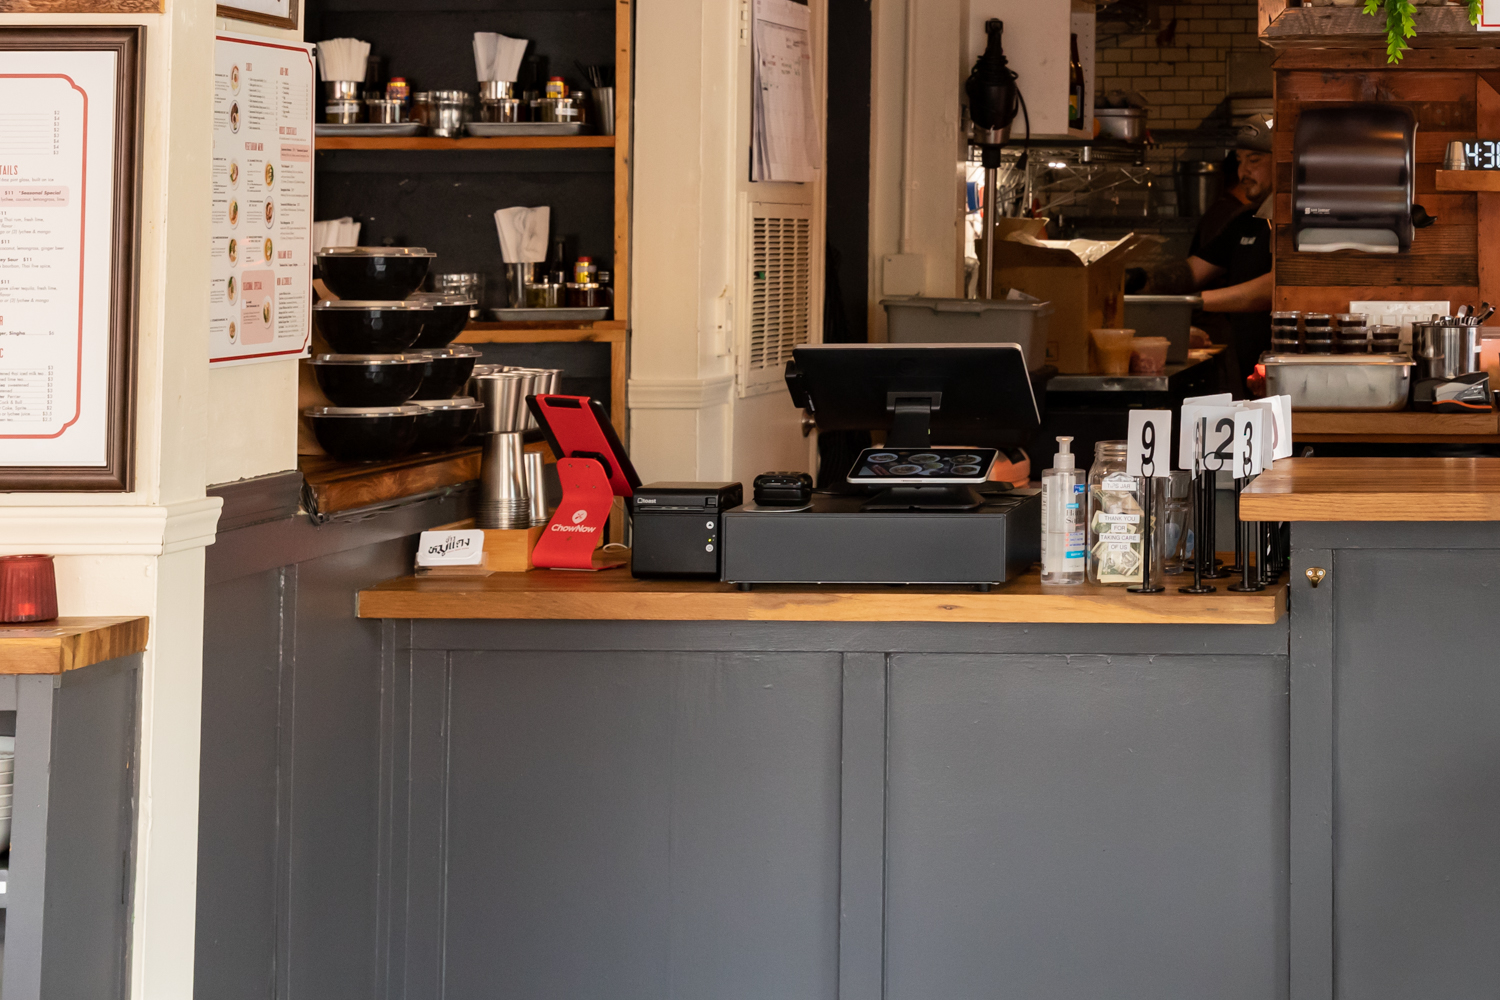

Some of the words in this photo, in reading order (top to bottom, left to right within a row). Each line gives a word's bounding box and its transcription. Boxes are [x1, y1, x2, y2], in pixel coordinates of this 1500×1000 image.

[0, 165, 18, 175] TAILS
[1142, 420, 1155, 464] 9
[1243, 421, 1252, 464] 3
[551, 524, 596, 532] ChowNow
